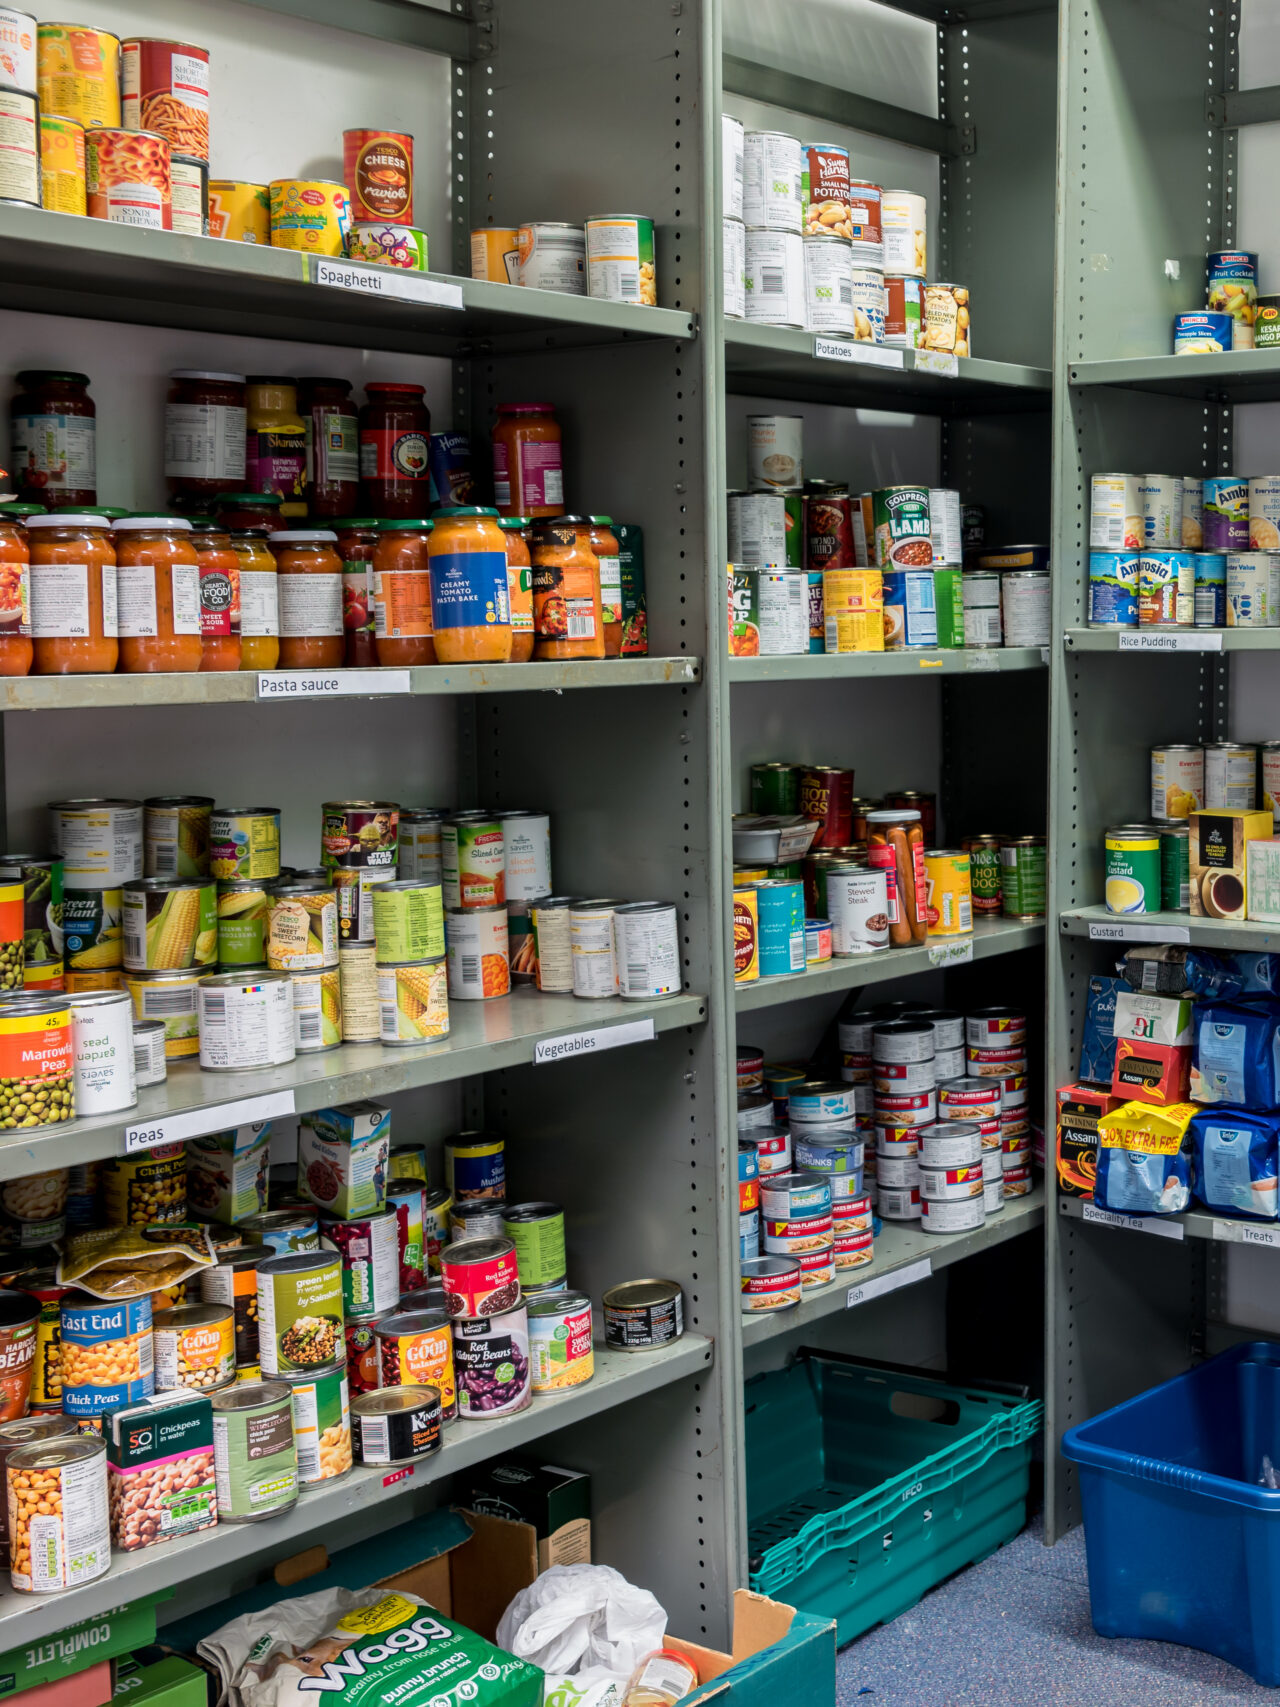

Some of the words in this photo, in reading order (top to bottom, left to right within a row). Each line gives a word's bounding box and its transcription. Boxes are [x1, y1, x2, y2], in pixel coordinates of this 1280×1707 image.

[364, 155, 406, 170] CHEESE
[364, 186, 407, 199] ravioli
[320, 267, 382, 290] Spaghetti
[817, 342, 852, 357] Potatoes
[890, 519, 930, 537] LAMB
[440, 580, 470, 589] CREAMY
[203, 587, 229, 598] FOOD
[440, 587, 472, 596] TOMATO
[437, 595, 457, 604] PASTA
[458, 594, 479, 602] BAKE
[1121, 636, 1139, 646] Rice
[1141, 636, 1177, 648] Pudding
[261, 679, 297, 693] Pasta
[301, 679, 339, 691] sauce
[801, 789, 830, 801] HOT
[509, 856, 535, 865] sliced
[508, 866, 537, 875] carrots
[974, 868, 997, 878] HOT
[1108, 866, 1133, 875] Custard
[847, 887, 875, 896] Stewed
[847, 896, 869, 905] Steak
[1091, 926, 1124, 937] Custard
[83, 1035, 109, 1048] peas
[537, 1035, 596, 1059] Vegetables
[77, 1048, 116, 1061] garden
[41, 1058, 67, 1072] Peas
[81, 1068, 114, 1080] savers
[1122, 1073, 1143, 1083] Assam
[129, 1127, 164, 1144] Peas
[1065, 1129, 1098, 1144] Assam
[1125, 1130, 1157, 1145] EXTRA
[1084, 1207, 1126, 1222] Speciality
[1127, 1216, 1143, 1228] Tea
[1244, 1228, 1273, 1243] Treats
[296, 1278, 321, 1289] green
[297, 1296, 309, 1308] by
[848, 1290, 864, 1302] Fish
[61, 1313, 87, 1329] East
[91, 1311, 122, 1329] End
[183, 1332, 220, 1349] GOOD
[469, 1342, 488, 1351] Red
[572, 1335, 590, 1347] SWEET
[186, 1344, 219, 1357] balanced
[406, 1339, 448, 1361] GOOD
[482, 1348, 511, 1361] Beans
[571, 1342, 591, 1354] CORN
[410, 1356, 446, 1370] balanced
[66, 1391, 95, 1405] Chick
[97, 1391, 120, 1404] Peas
[160, 1419, 201, 1436] Chickpeas
[167, 1431, 186, 1440] water
[129, 1444, 153, 1455] organic
[27, 1624, 110, 1669] COMPLETE
[301, 1617, 455, 1693] Wagg
[344, 1670, 383, 1703] Healthy
[386, 1657, 411, 1676] from
[413, 1647, 437, 1663] nose
[438, 1641, 450, 1650] to
[380, 1676, 420, 1705] bunny
[420, 1651, 468, 1684] brunch
